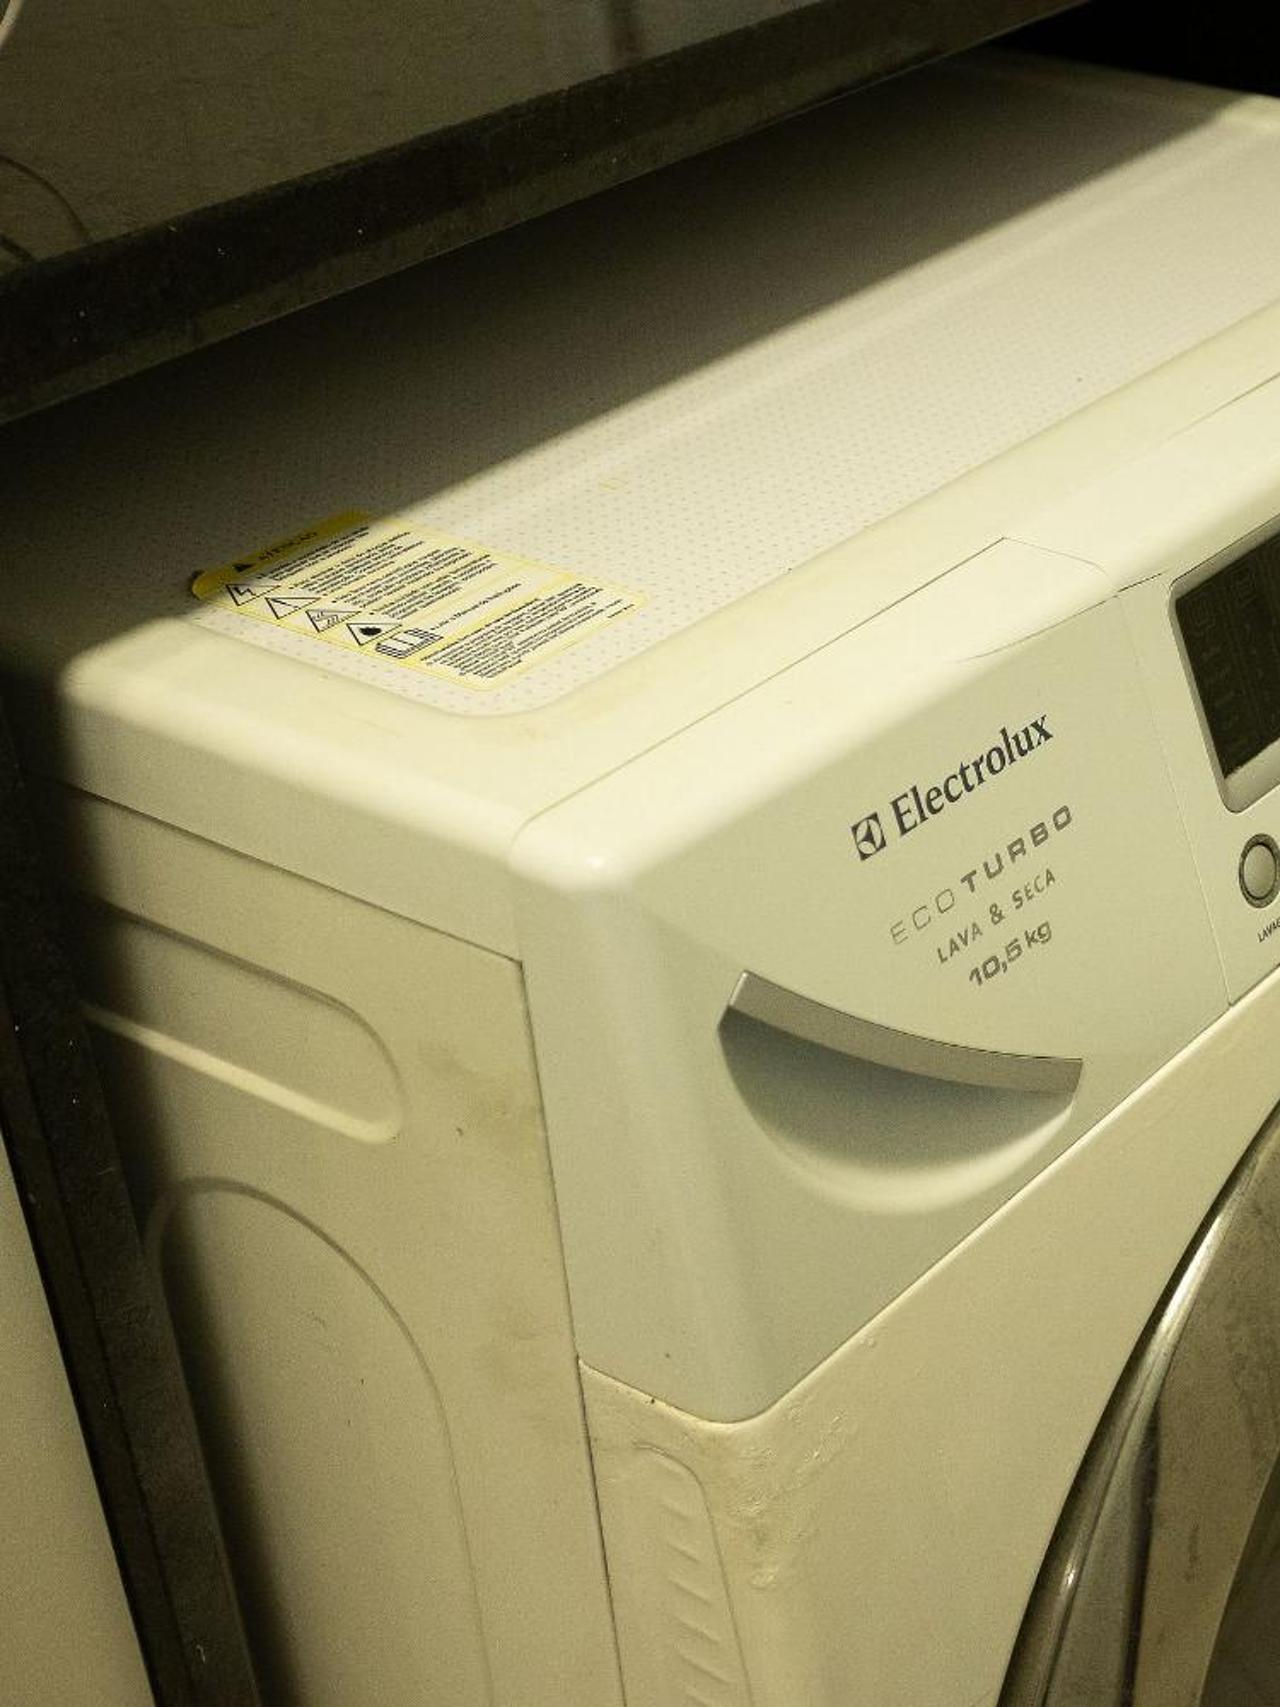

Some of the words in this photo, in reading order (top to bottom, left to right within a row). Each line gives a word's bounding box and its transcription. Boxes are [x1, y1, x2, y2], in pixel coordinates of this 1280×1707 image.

[889, 714, 1054, 837] Electrolux
[936, 922, 984, 964] LAVA
[988, 902, 1006, 926] &
[1011, 868, 1057, 911] SECA
